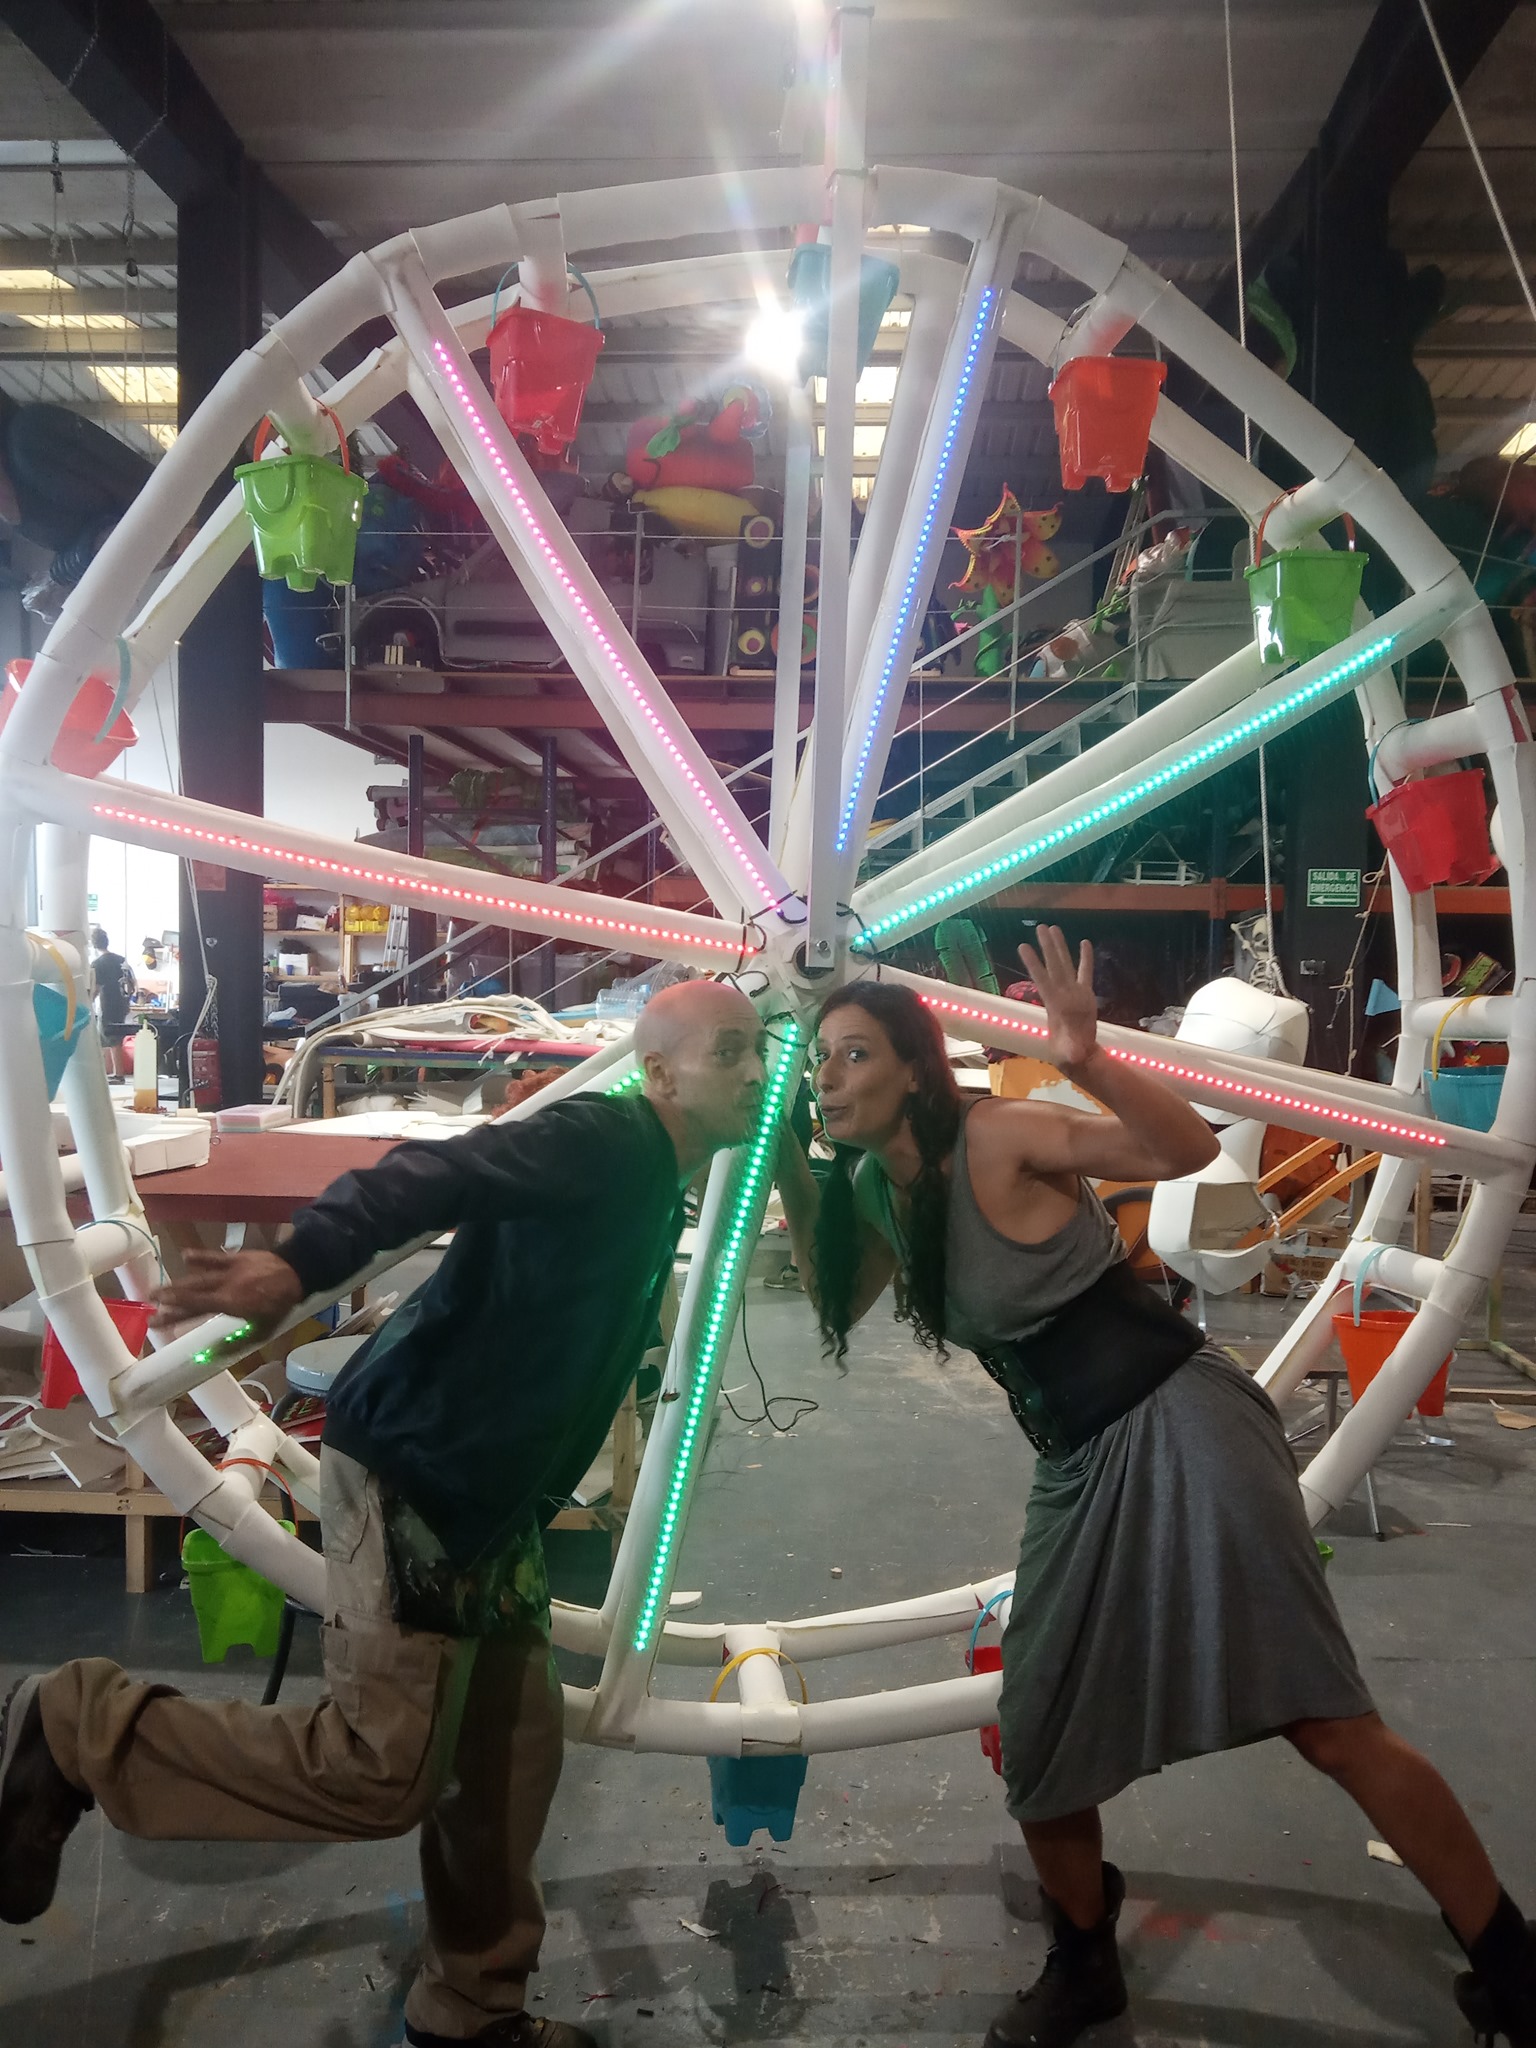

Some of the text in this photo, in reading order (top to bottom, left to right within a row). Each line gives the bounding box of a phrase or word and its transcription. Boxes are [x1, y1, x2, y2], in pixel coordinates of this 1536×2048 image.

[1312, 871, 1357, 881] SALIDA DE
[1310, 883, 1358, 893] EMERGENCIA
